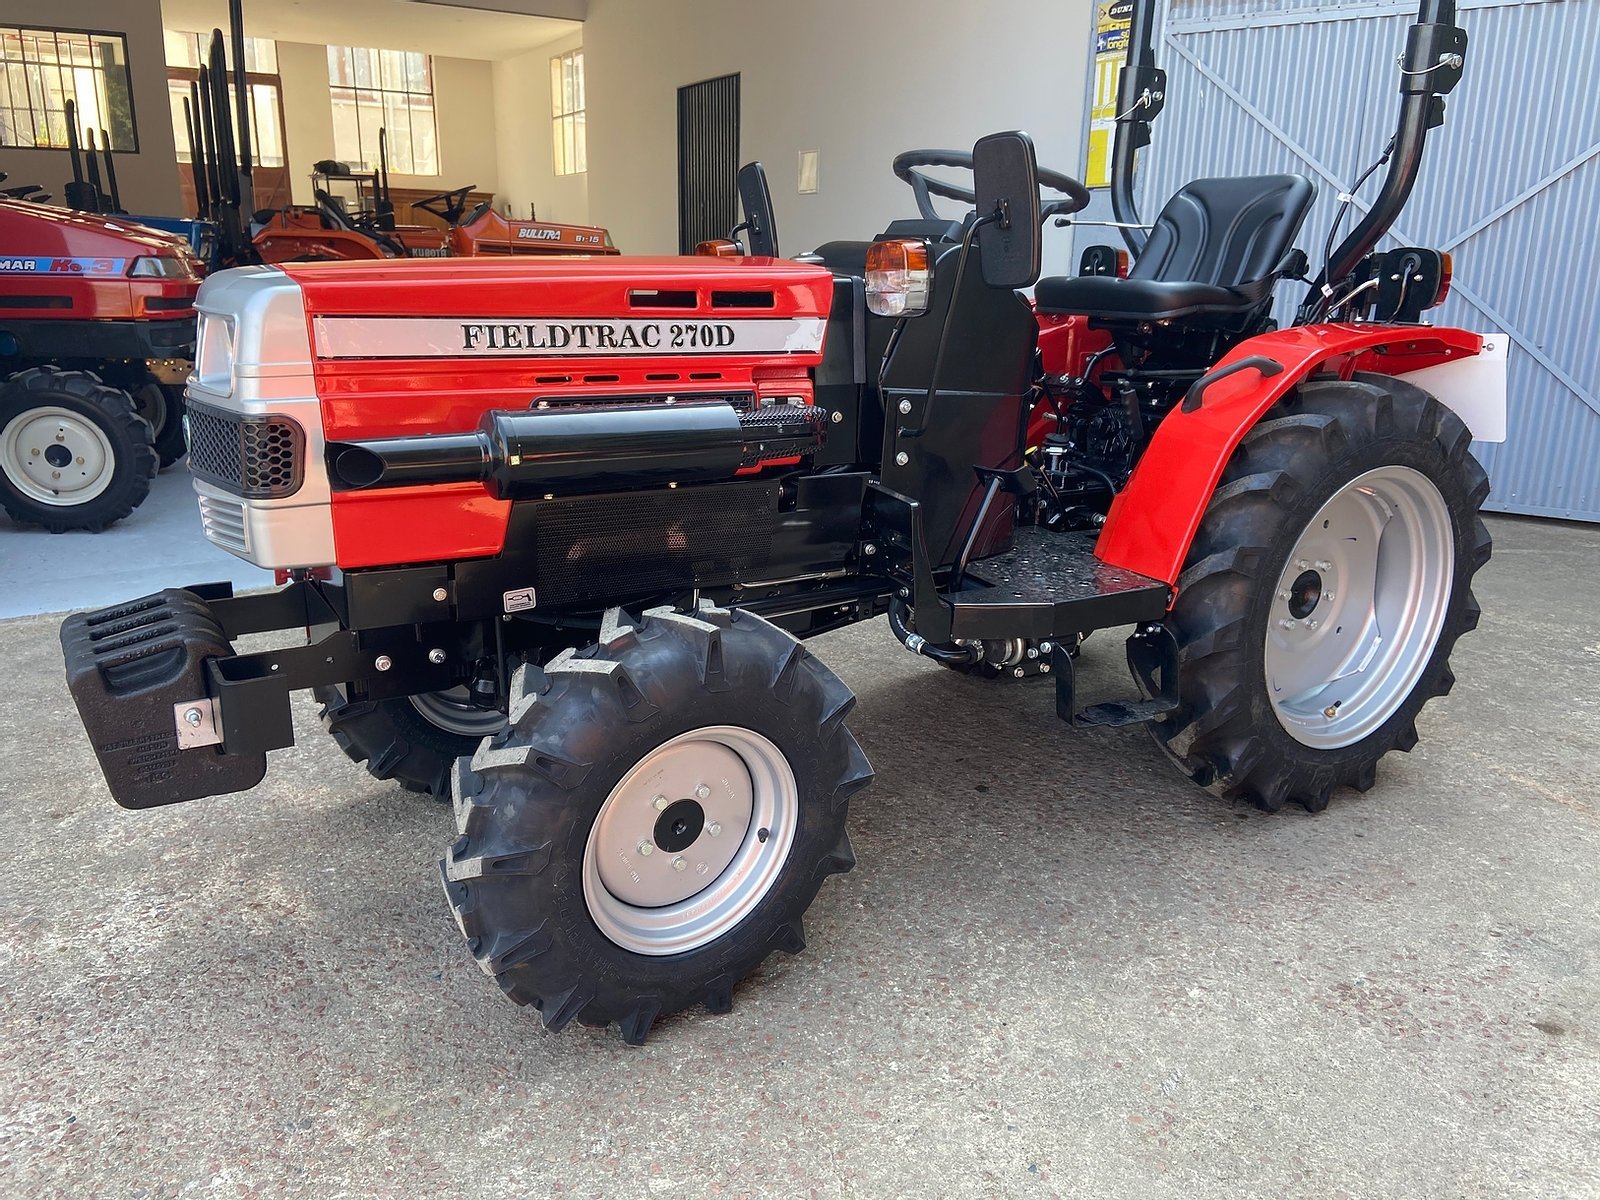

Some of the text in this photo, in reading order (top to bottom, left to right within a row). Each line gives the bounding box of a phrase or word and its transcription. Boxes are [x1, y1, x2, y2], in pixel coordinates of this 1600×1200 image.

[518, 228, 561, 240] BULLTRA
[412, 247, 447, 257] KUBOTA
[461, 323, 735, 350] FIELDTRAC 270D
